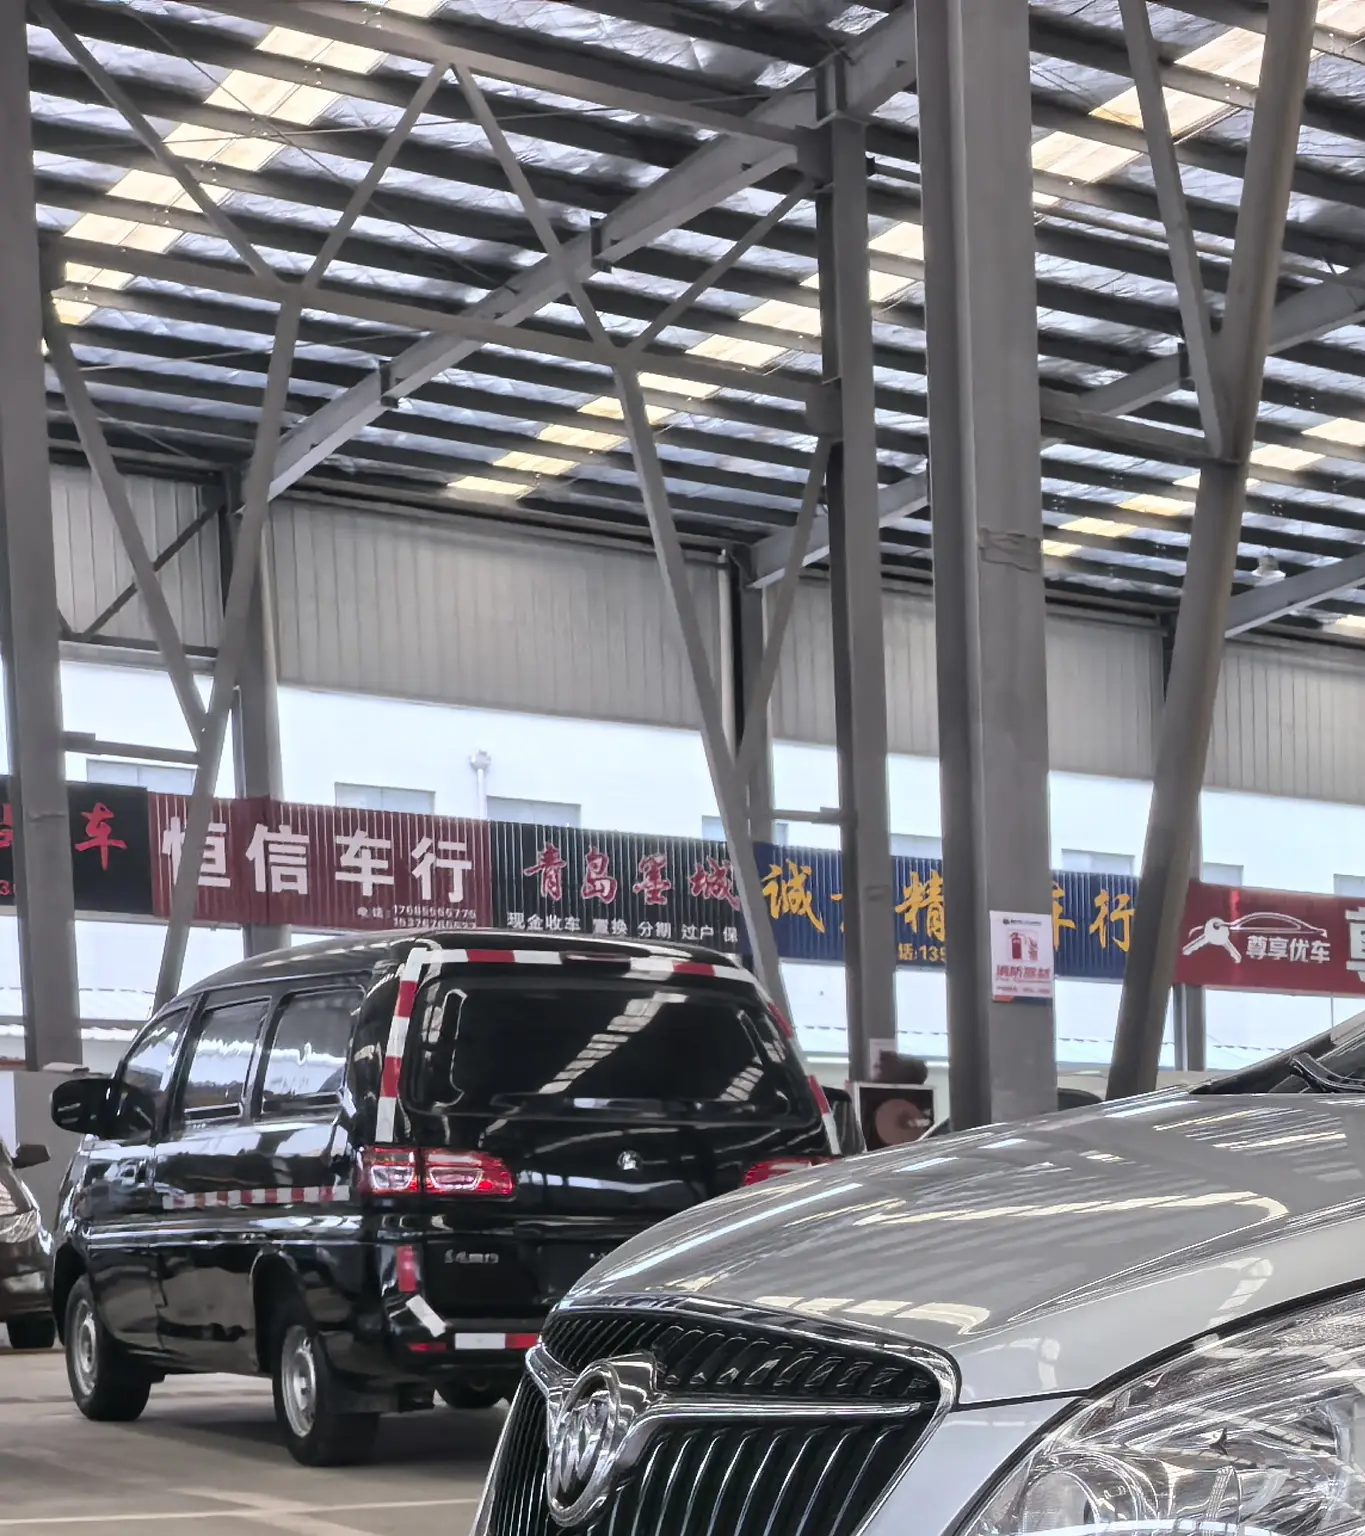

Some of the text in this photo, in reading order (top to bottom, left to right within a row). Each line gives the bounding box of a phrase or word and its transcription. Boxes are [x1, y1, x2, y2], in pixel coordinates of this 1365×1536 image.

[162, 815, 473, 903] 恒信车行
[507, 911, 581, 932] 现金收车
[637, 921, 672, 939] 分期
[681, 924, 715, 941] 过户
[1246, 934, 1331, 964] 尊享优车
